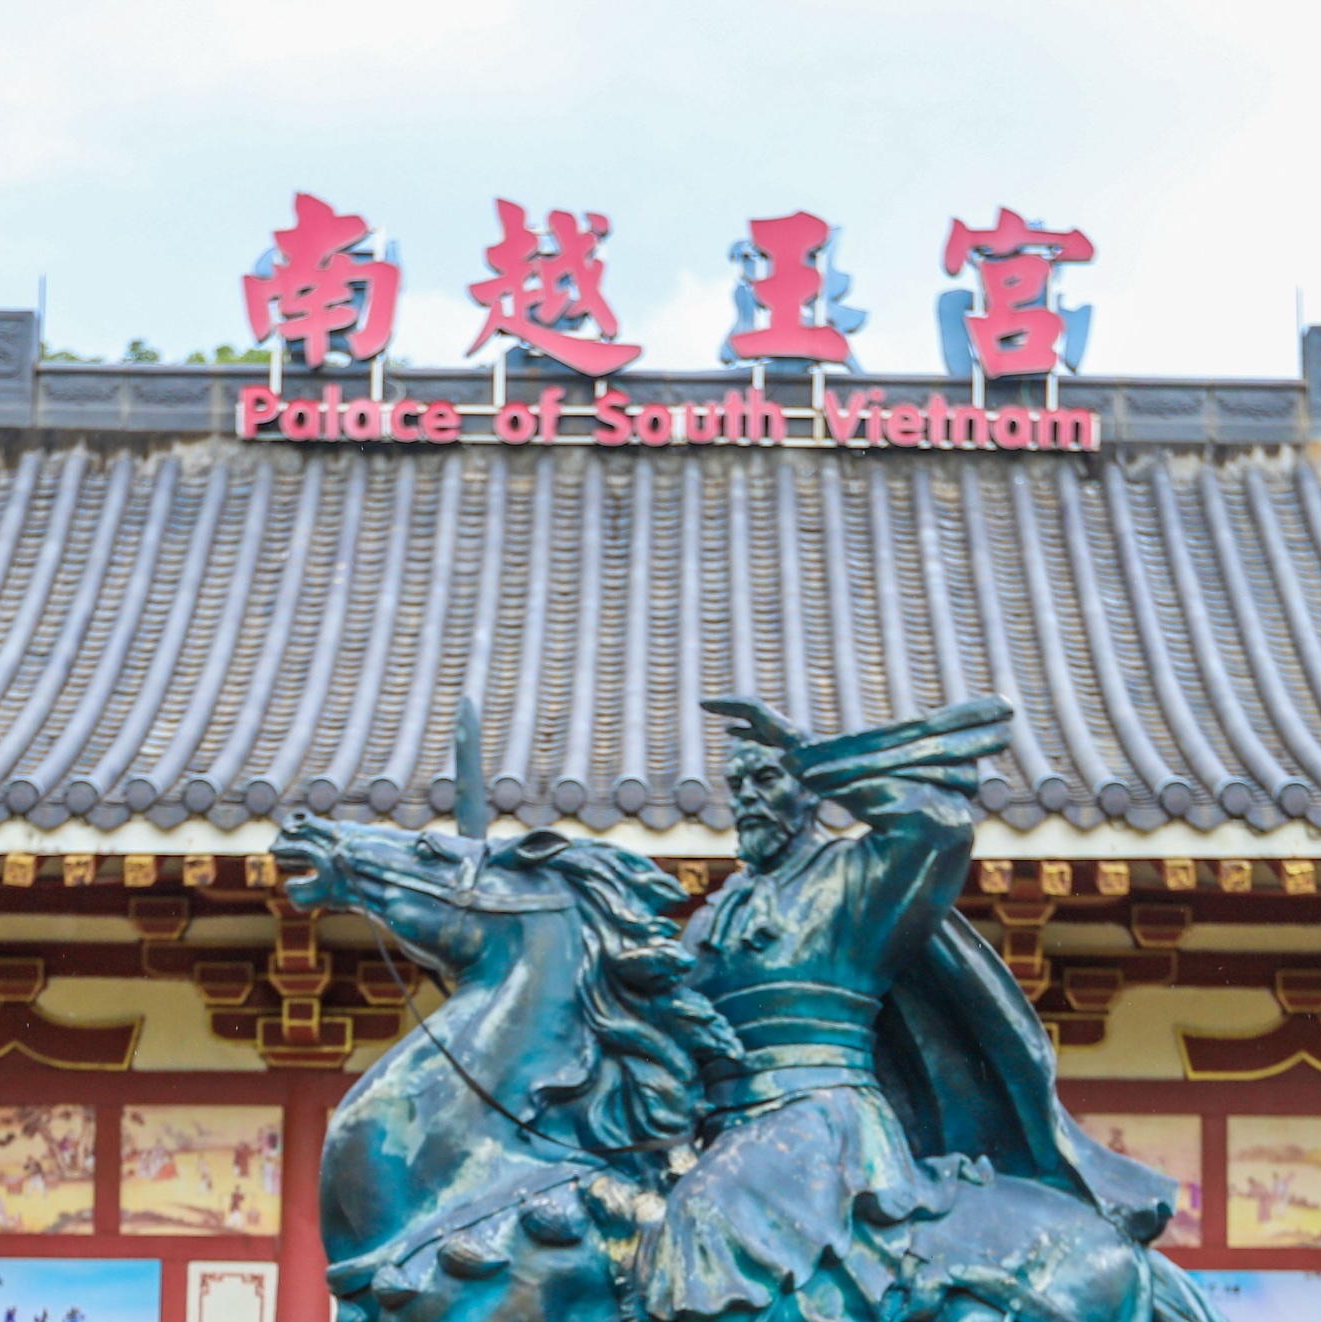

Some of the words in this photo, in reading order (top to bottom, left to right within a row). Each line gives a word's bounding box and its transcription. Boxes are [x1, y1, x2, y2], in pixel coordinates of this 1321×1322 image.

[240, 190, 1095, 379] 南越王宫
[241, 386, 463, 443] Palace
[493, 386, 565, 446] of
[593, 388, 788, 448] South
[822, 388, 1095, 450] Vietnam
